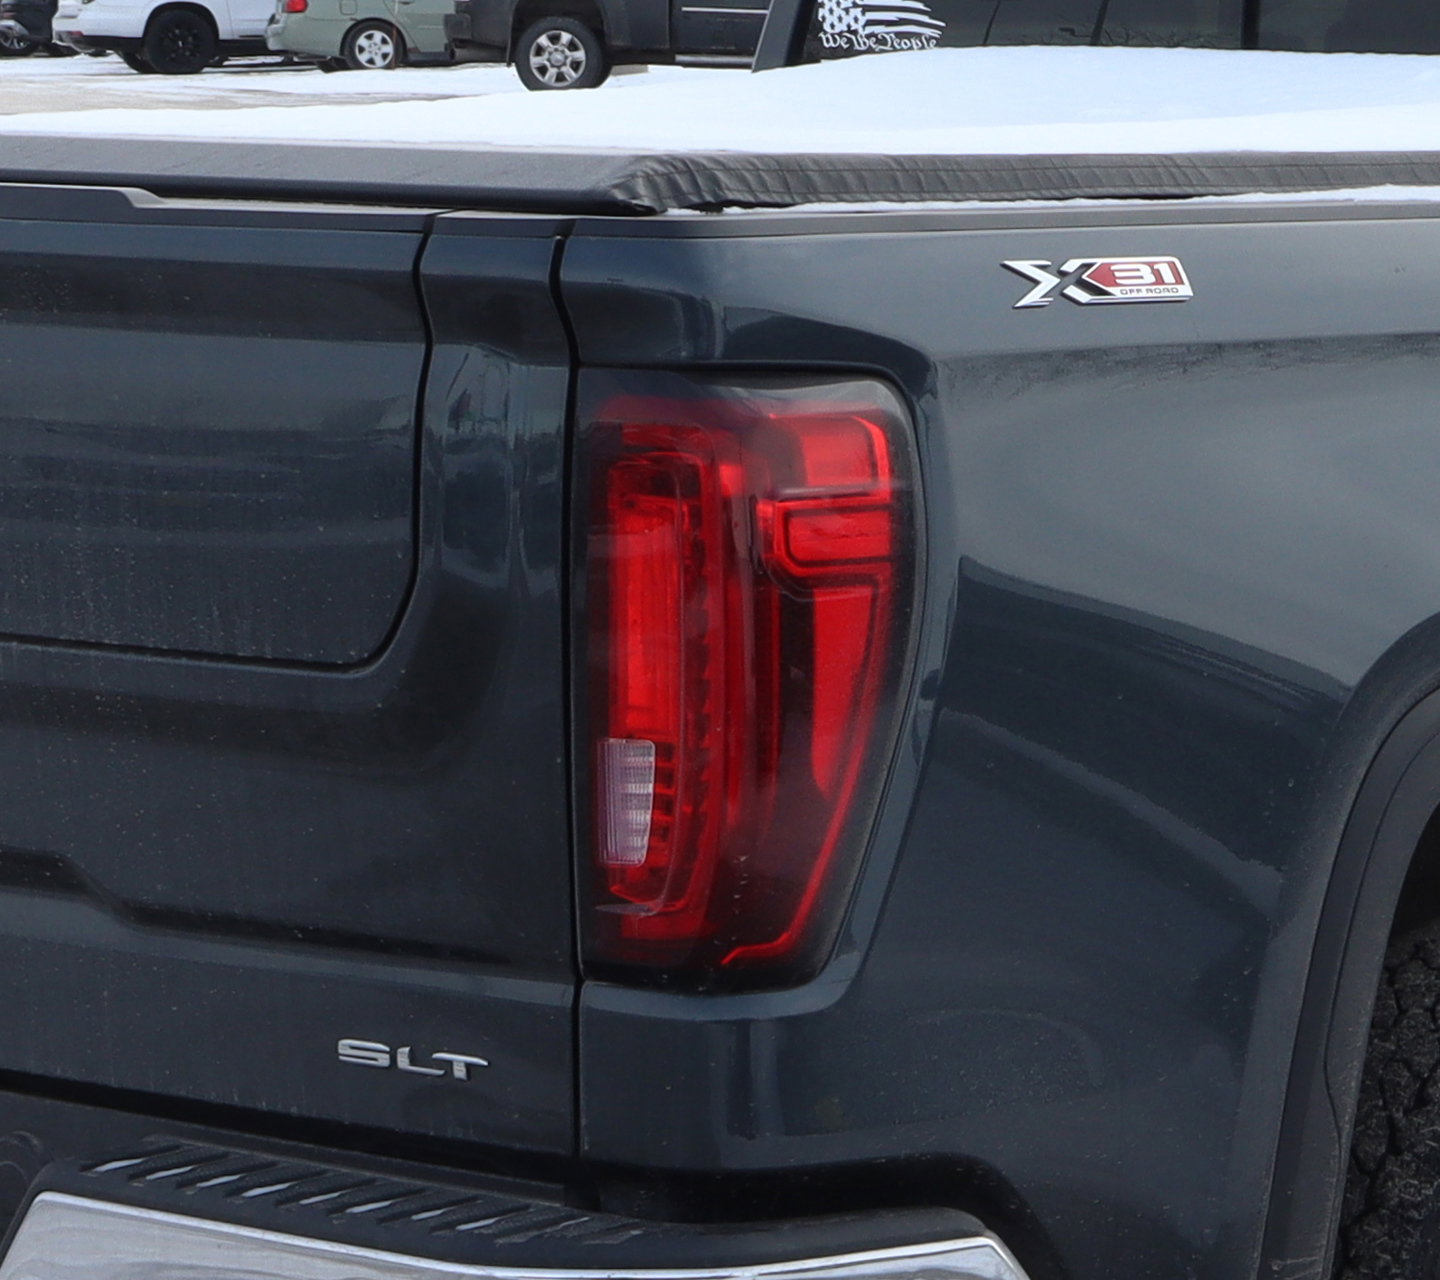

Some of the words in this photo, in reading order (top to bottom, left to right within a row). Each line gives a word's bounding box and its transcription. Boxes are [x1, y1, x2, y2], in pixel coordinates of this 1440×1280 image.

[818, 31, 850, 49] We
[1119, 288, 1144, 296] OFF
[1146, 287, 1180, 295] ROAD
[337, 1039, 489, 1081] SLT
